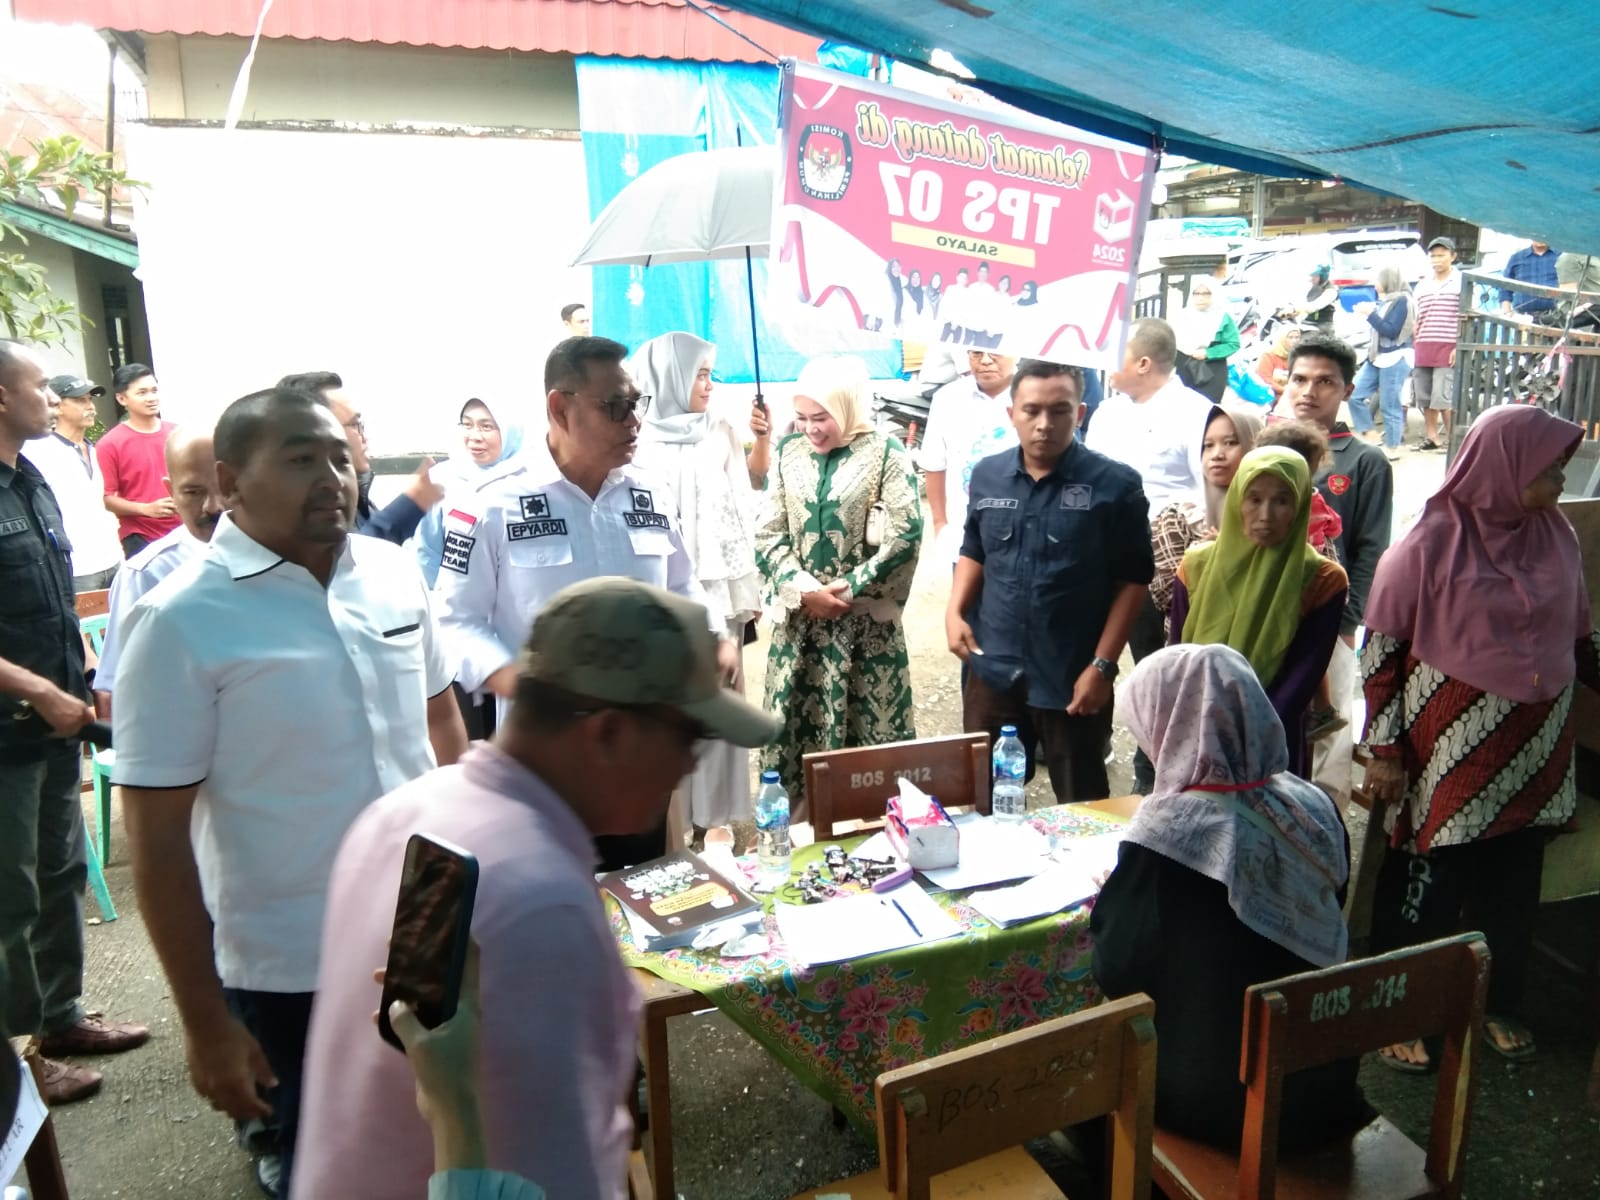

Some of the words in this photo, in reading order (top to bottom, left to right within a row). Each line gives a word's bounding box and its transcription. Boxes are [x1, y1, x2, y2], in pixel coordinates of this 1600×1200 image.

[626, 513, 667, 528] BUPATI
[511, 520, 565, 538] EPYARDI
[447, 535, 471, 549] SOLOK
[445, 545, 469, 559] SUPER
[444, 555, 467, 569] TEAM
[850, 769, 885, 789] BOS
[1309, 984, 1352, 1024] BOS
[937, 1076, 1002, 1135] BOS
